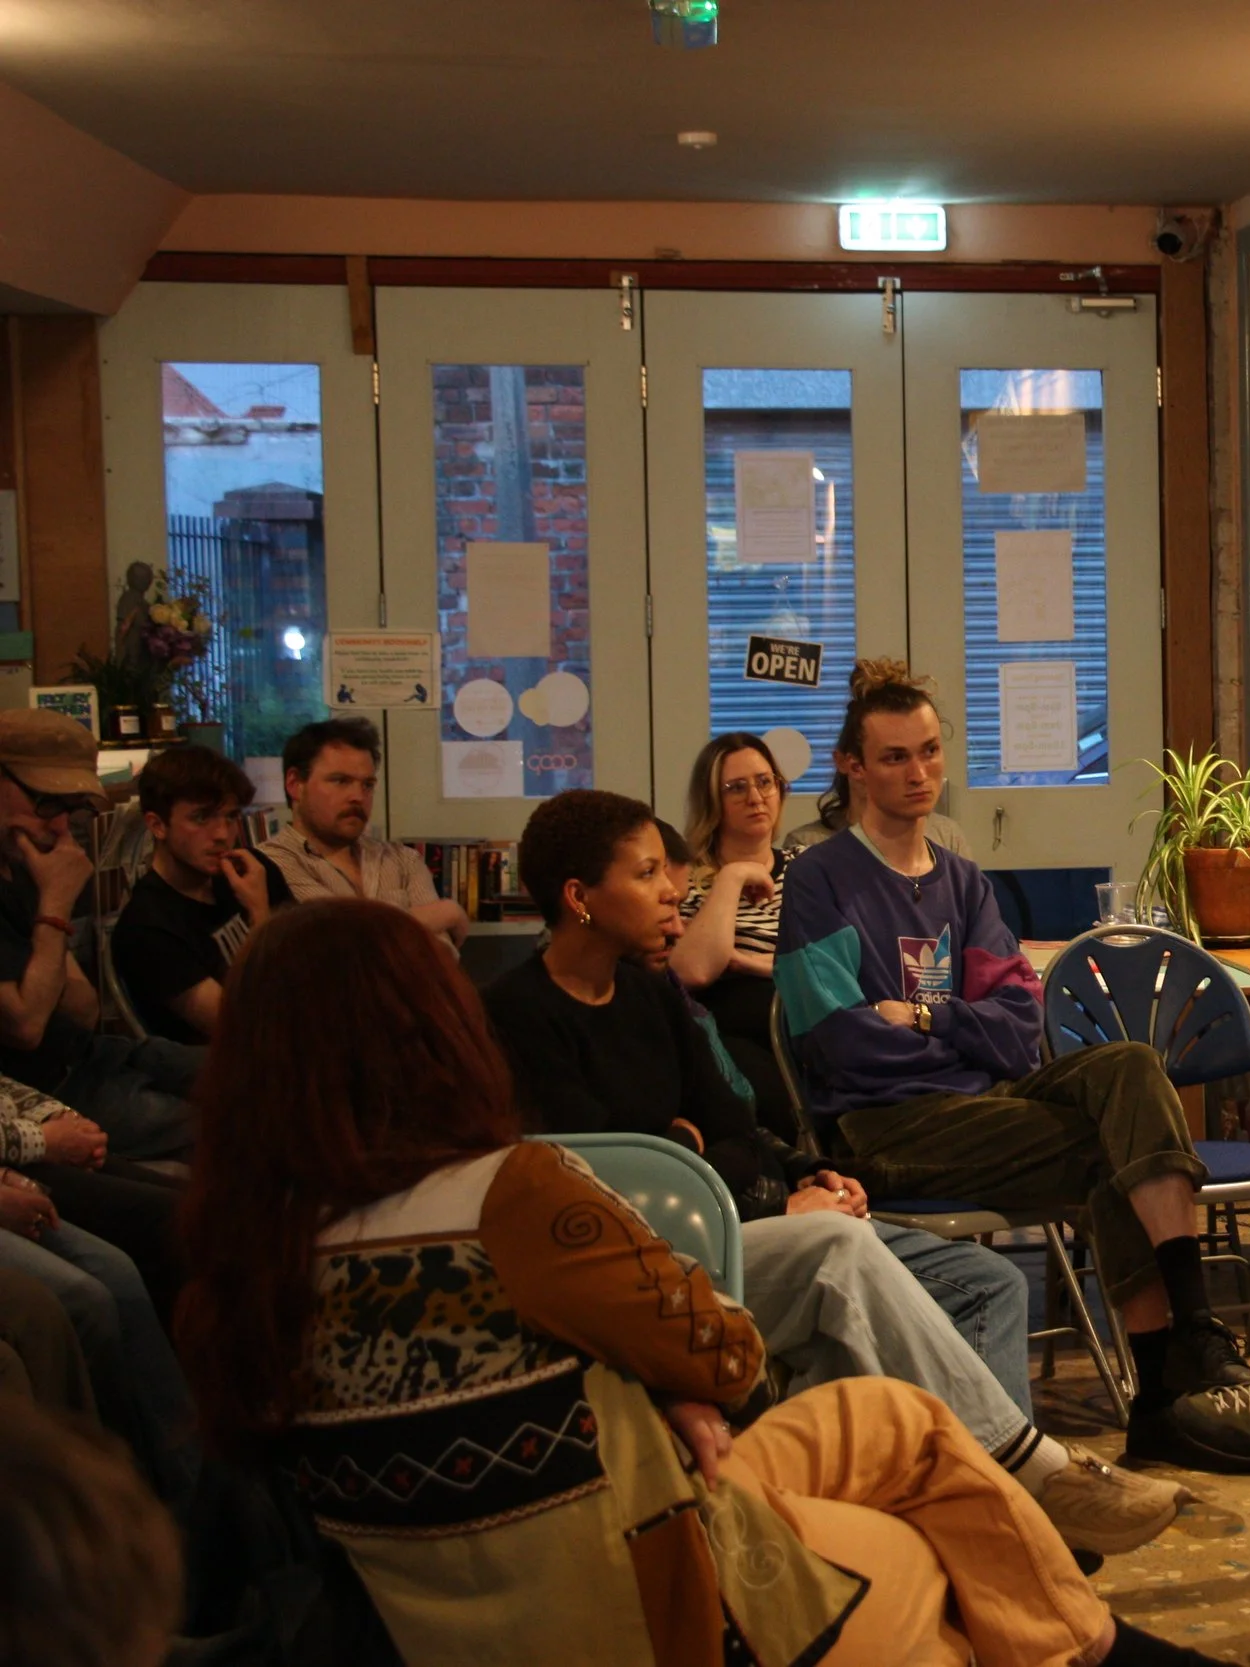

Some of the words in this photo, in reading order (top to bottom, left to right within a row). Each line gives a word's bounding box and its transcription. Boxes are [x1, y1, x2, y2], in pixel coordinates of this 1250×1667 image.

[770, 643, 801, 656] WE'RE
[751, 653, 817, 682] OPEN
[915, 991, 951, 1004] adida
